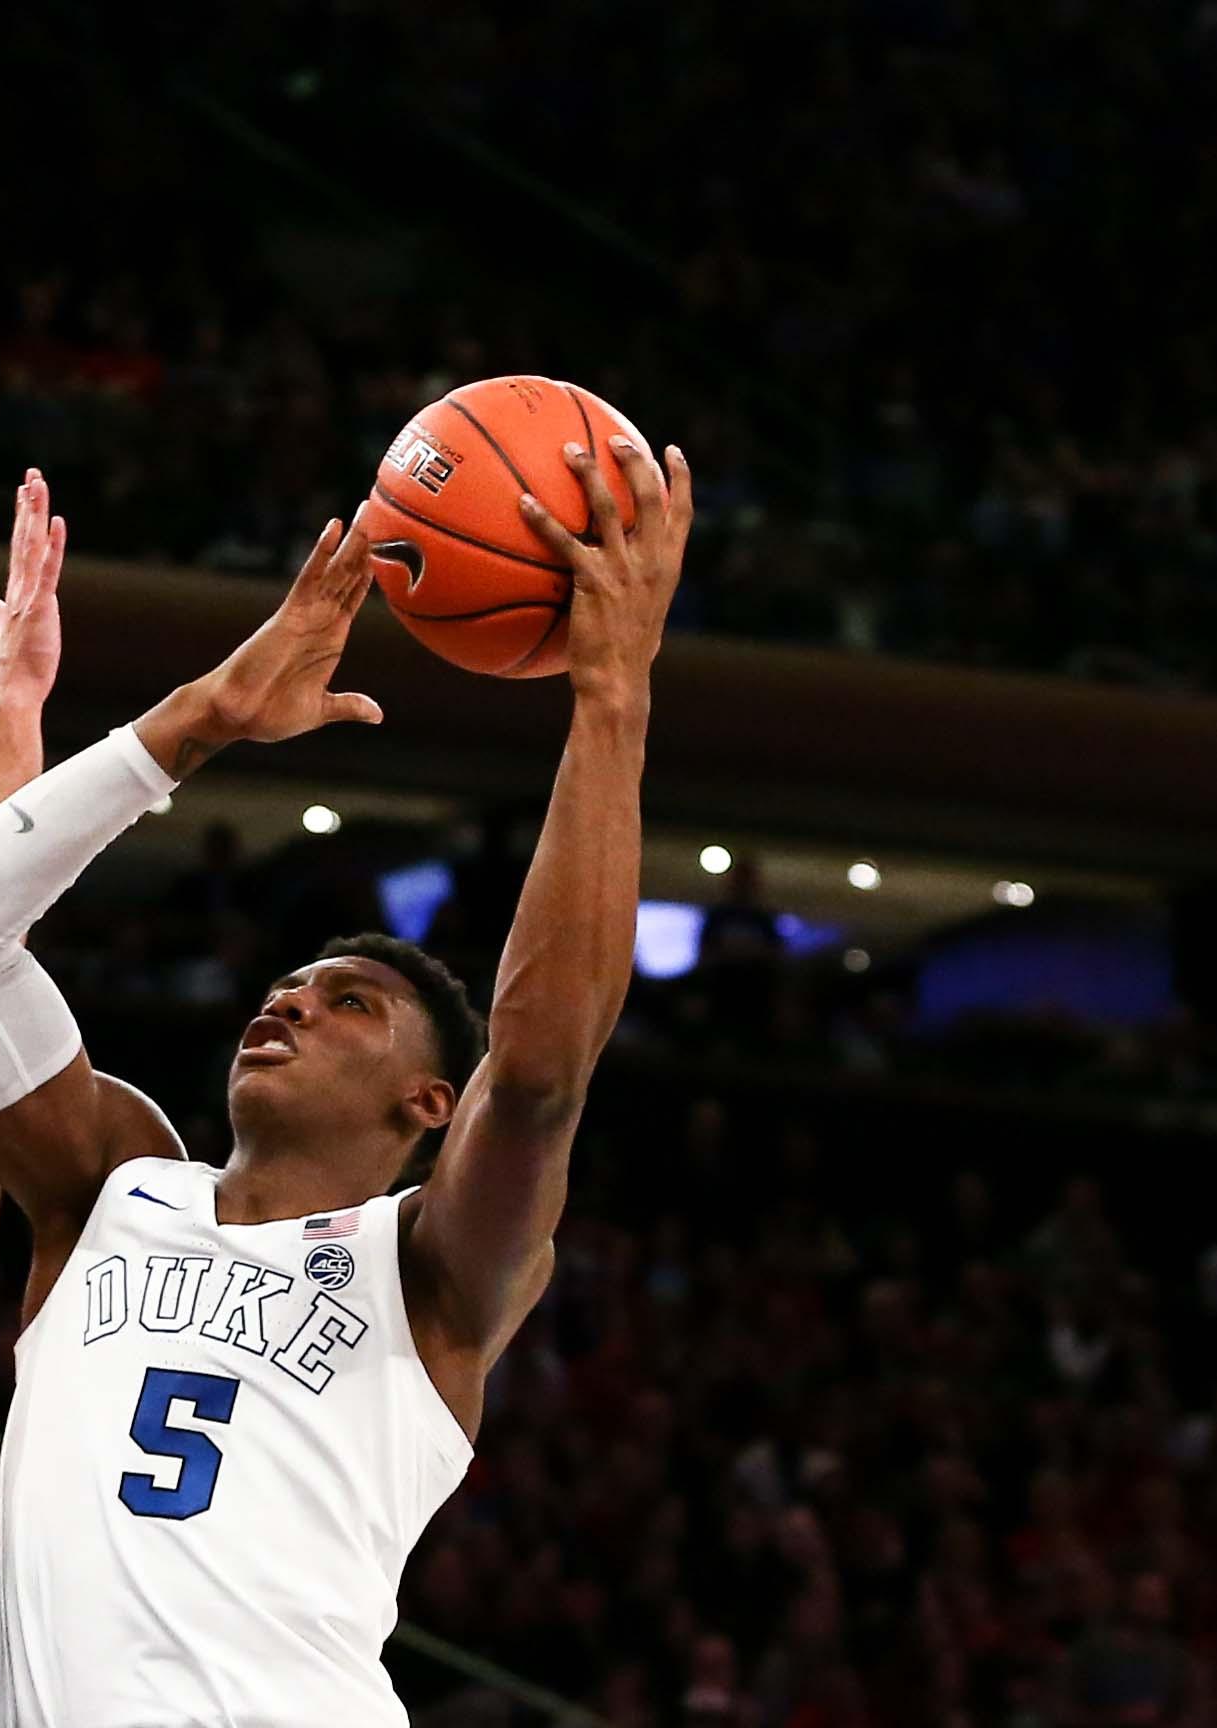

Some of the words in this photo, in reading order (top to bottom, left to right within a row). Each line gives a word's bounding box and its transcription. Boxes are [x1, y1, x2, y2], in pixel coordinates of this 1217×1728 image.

[83, 1254, 369, 1396] DUKE
[311, 1258, 351, 1270] ACC
[117, 1366, 241, 1521] 5
